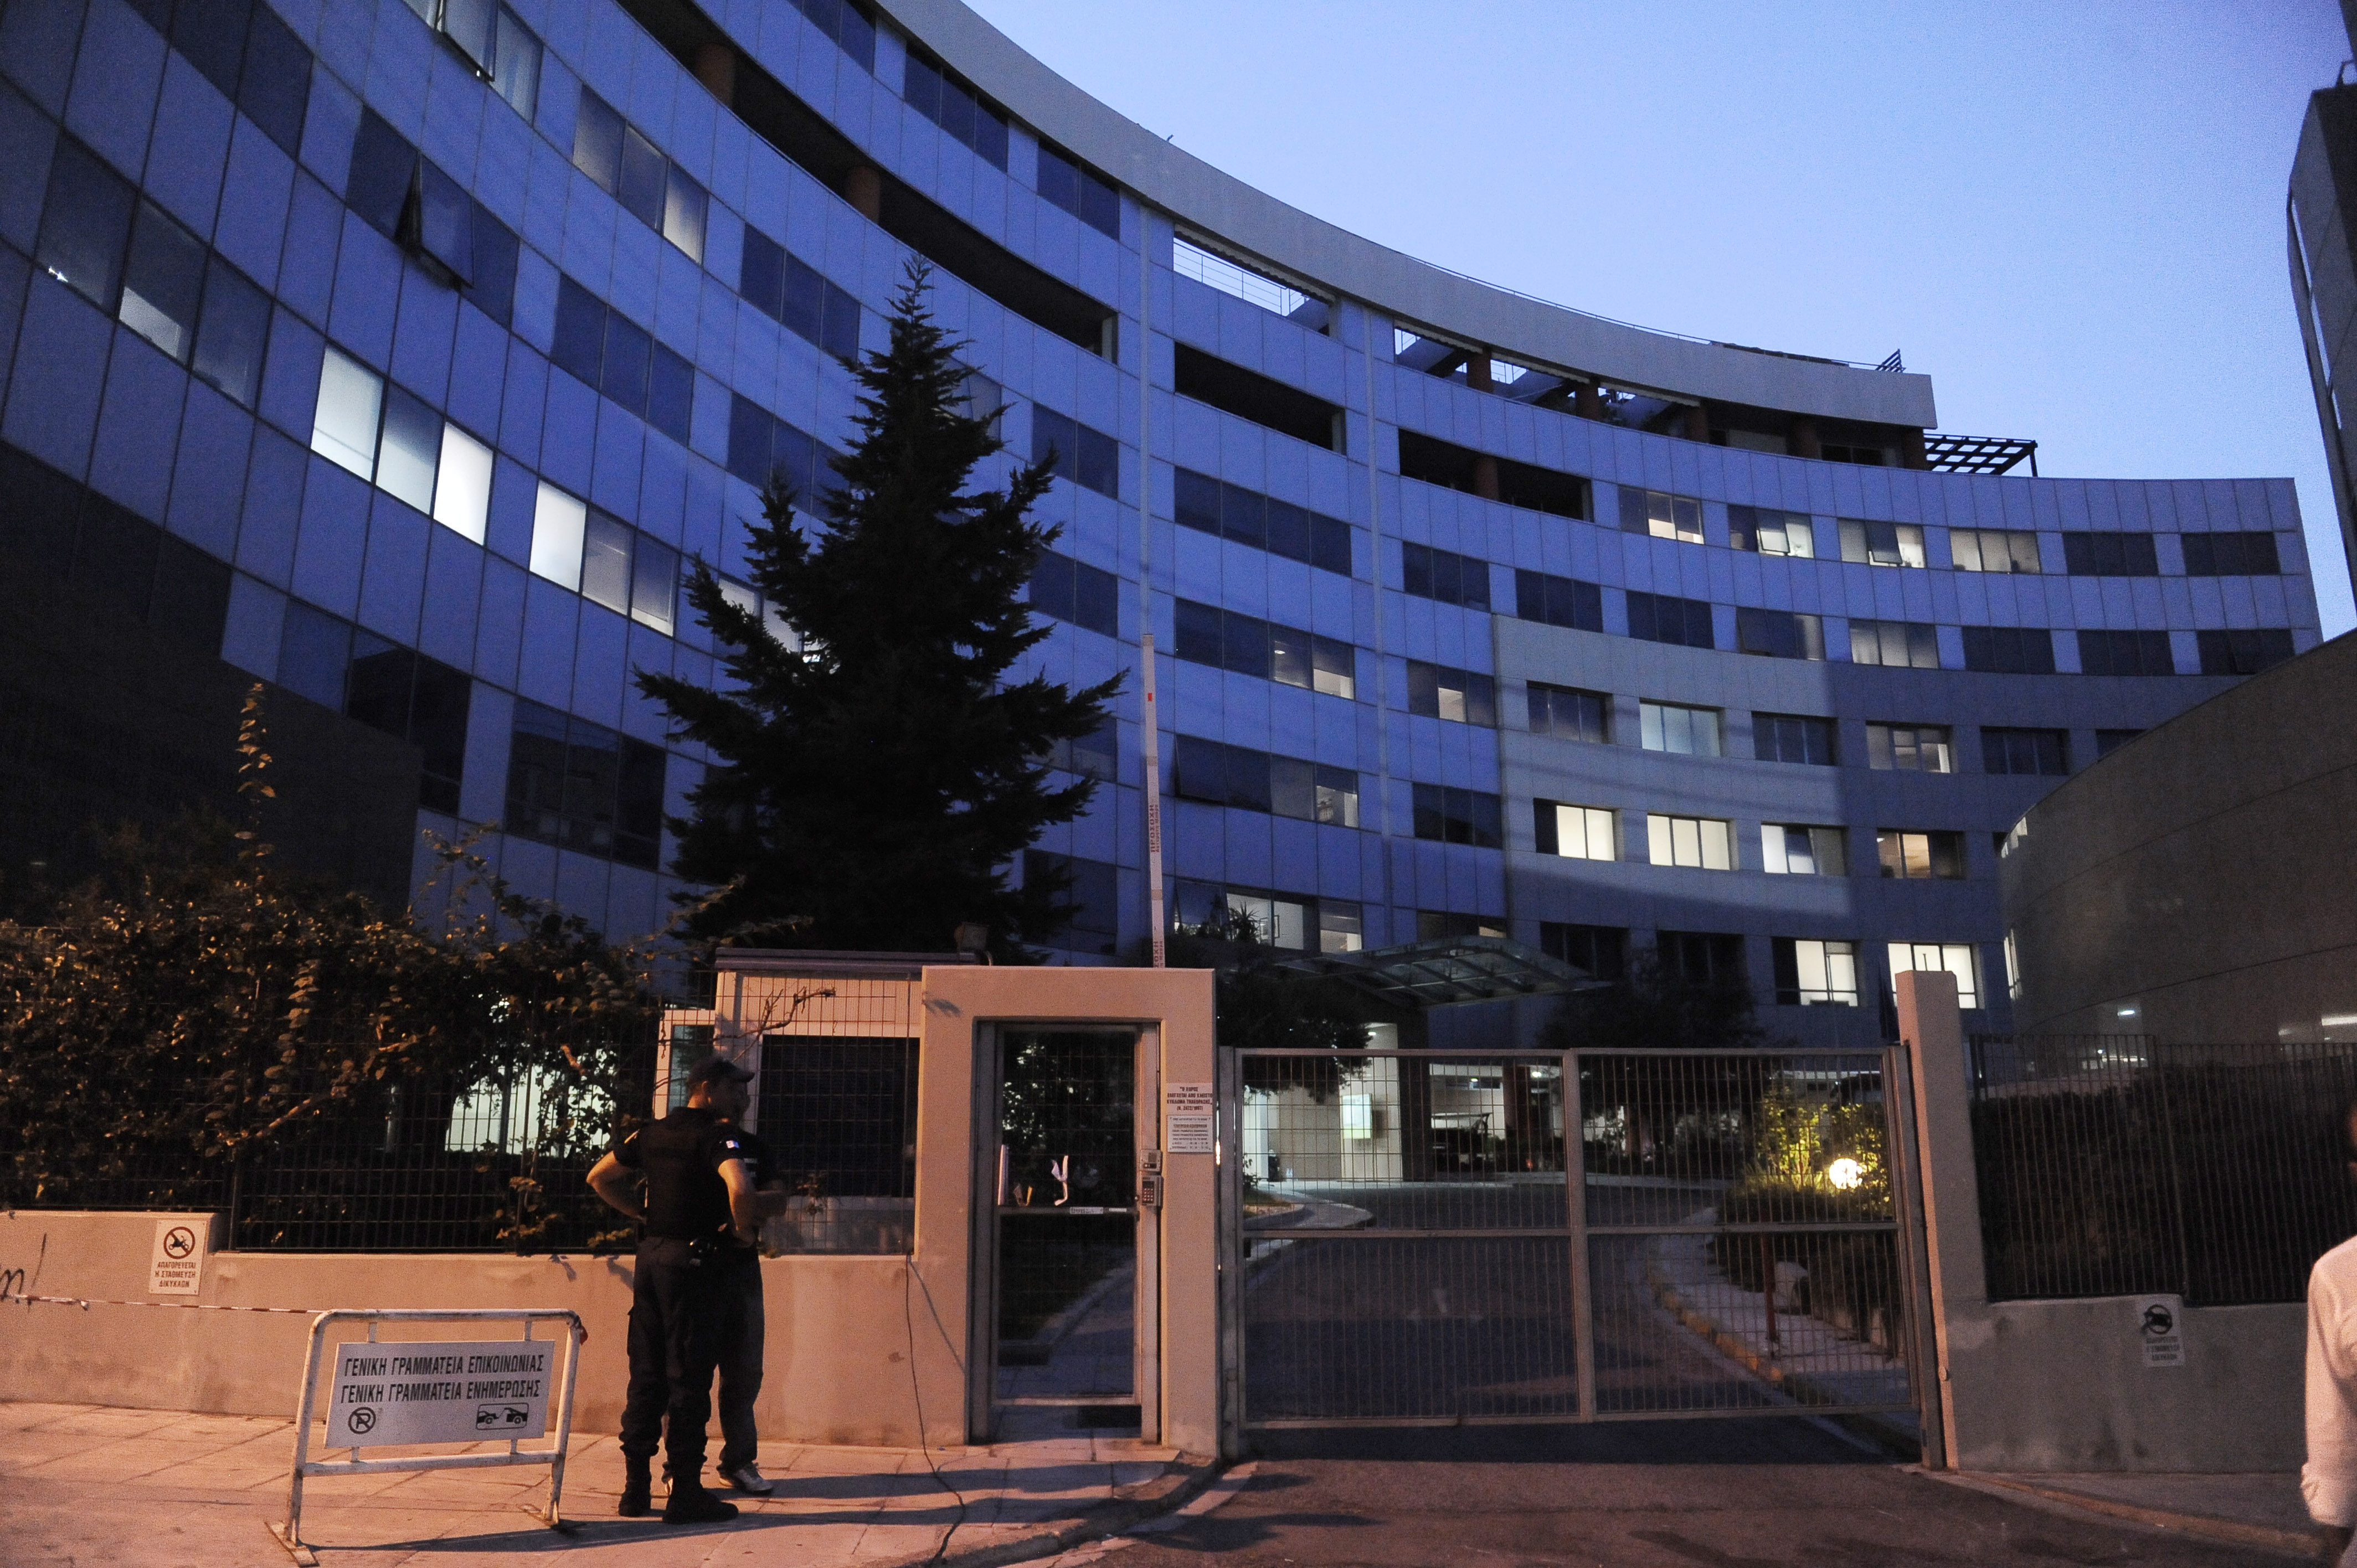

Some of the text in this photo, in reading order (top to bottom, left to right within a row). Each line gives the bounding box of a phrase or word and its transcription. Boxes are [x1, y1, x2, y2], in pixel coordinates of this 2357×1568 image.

[344, 1354, 544, 1376] ΓΕΝΙΚΗ ΓΡΑΜΜΑΤΕΙΑ ΕΠΙΚΟΙΝΩΝΙΑΣ
[341, 1380, 541, 1404] ΓΕΝΙΚΗ ΓΡΑΜΜΑΤΕΙΑ ΕΝΗΜΕΡΩΣΗΣ
